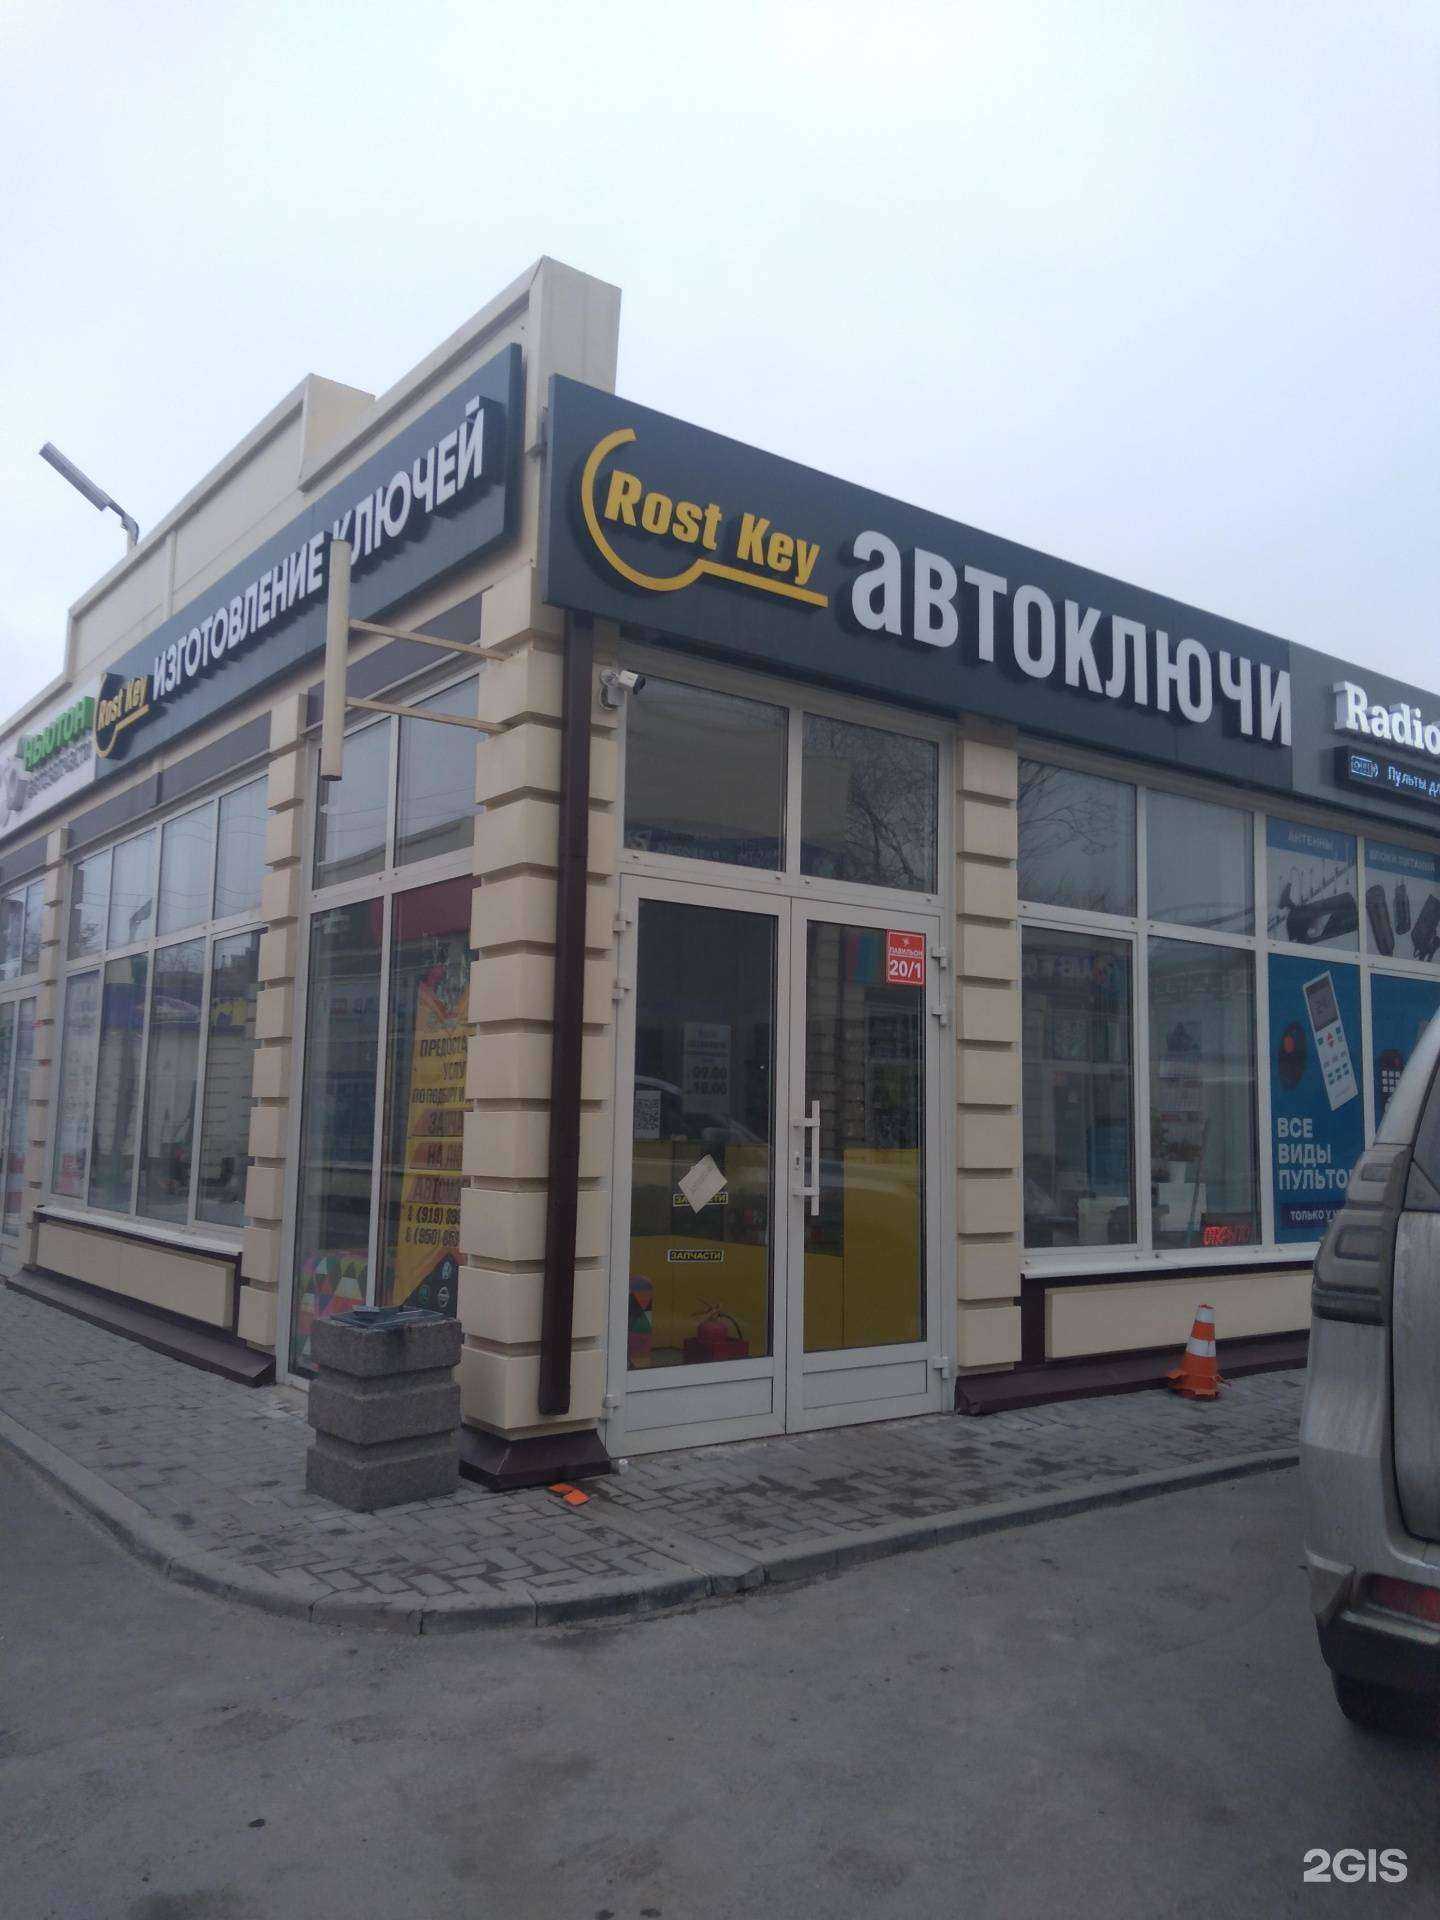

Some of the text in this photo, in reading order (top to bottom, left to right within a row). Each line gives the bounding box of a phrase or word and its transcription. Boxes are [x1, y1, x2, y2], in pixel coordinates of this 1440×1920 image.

[604, 470, 820, 585] Rost Key
[153, 531, 325, 700] ИЗГОТОВЛЕНИЕ
[889, 959, 922, 979] 20/1
[1277, 1117, 1314, 1138] ВСЕ
[1278, 1143, 1332, 1168] ВИДЫ
[1290, 1210, 1325, 1221] ТОЛЬКО
[670, 1251, 721, 1262] ЗАПЧАСТИ
